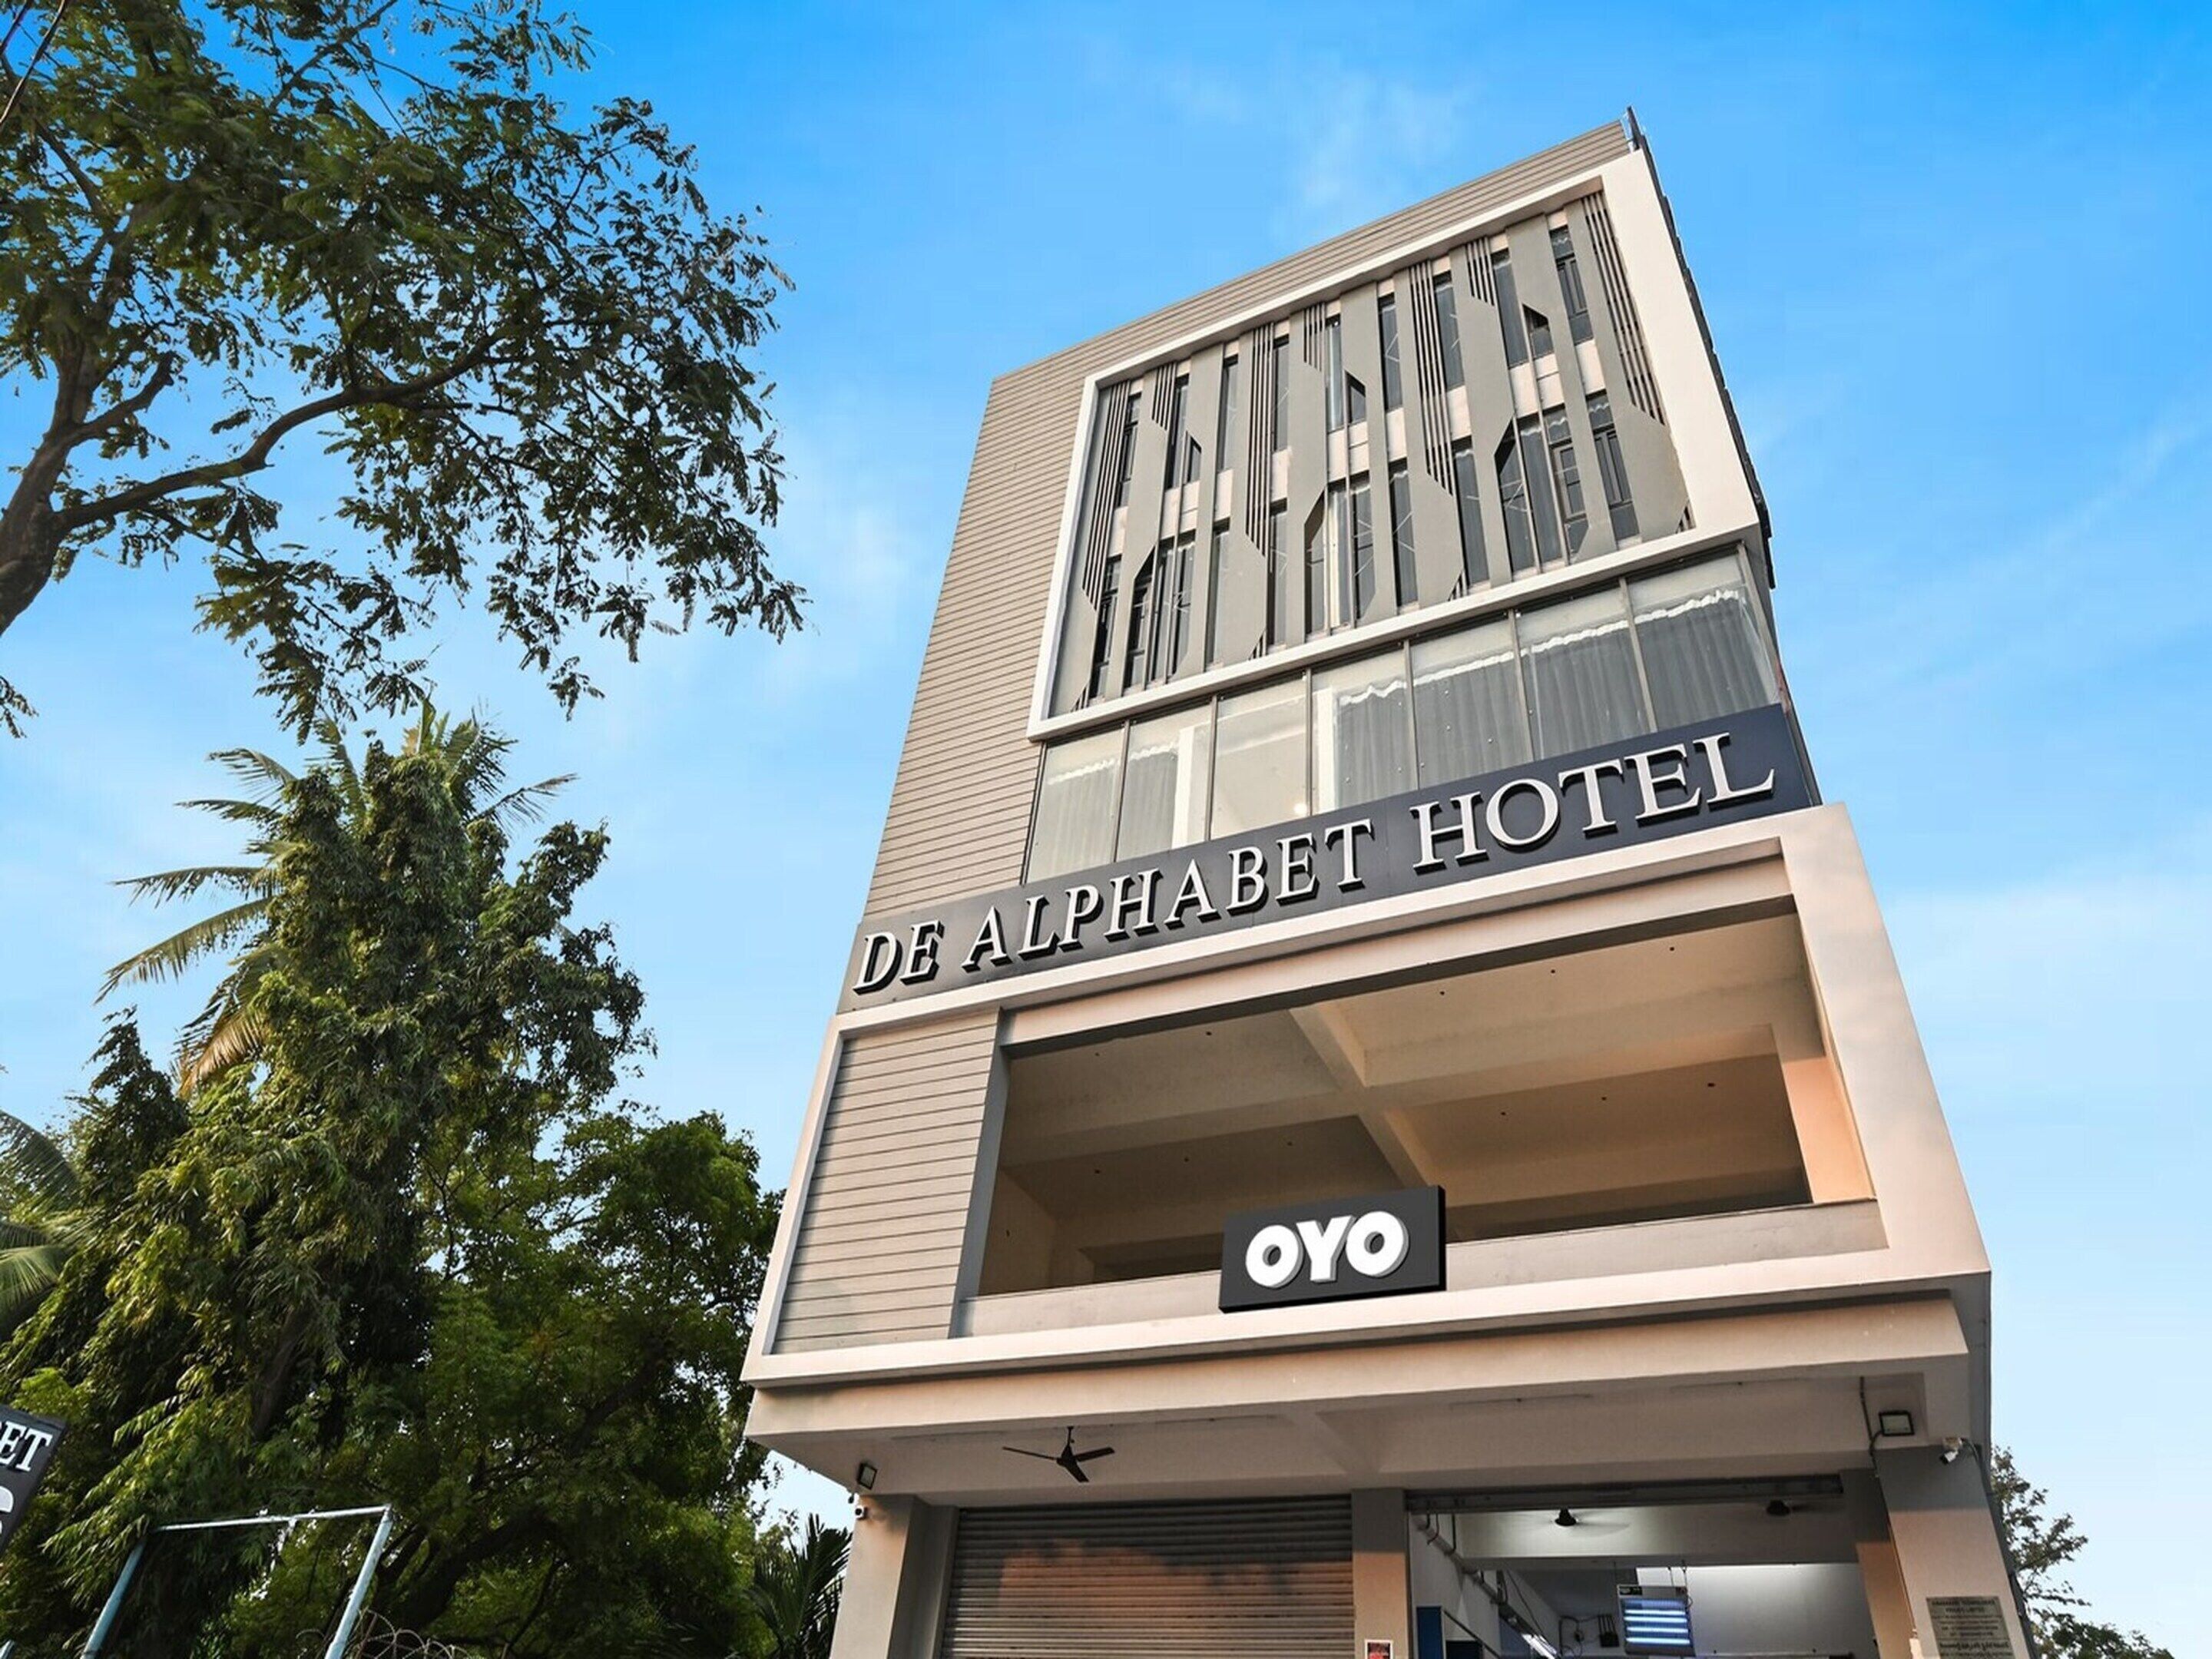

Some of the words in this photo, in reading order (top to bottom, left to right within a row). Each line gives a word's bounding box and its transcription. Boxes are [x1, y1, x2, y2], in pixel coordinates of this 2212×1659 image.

[853, 920, 944, 995] DE
[962, 819, 1375, 972] ALPHABET
[1409, 732, 1775, 874] HOTEL
[1245, 1210, 1409, 1289] OYO
[0, 1421, 53, 1472] ET
